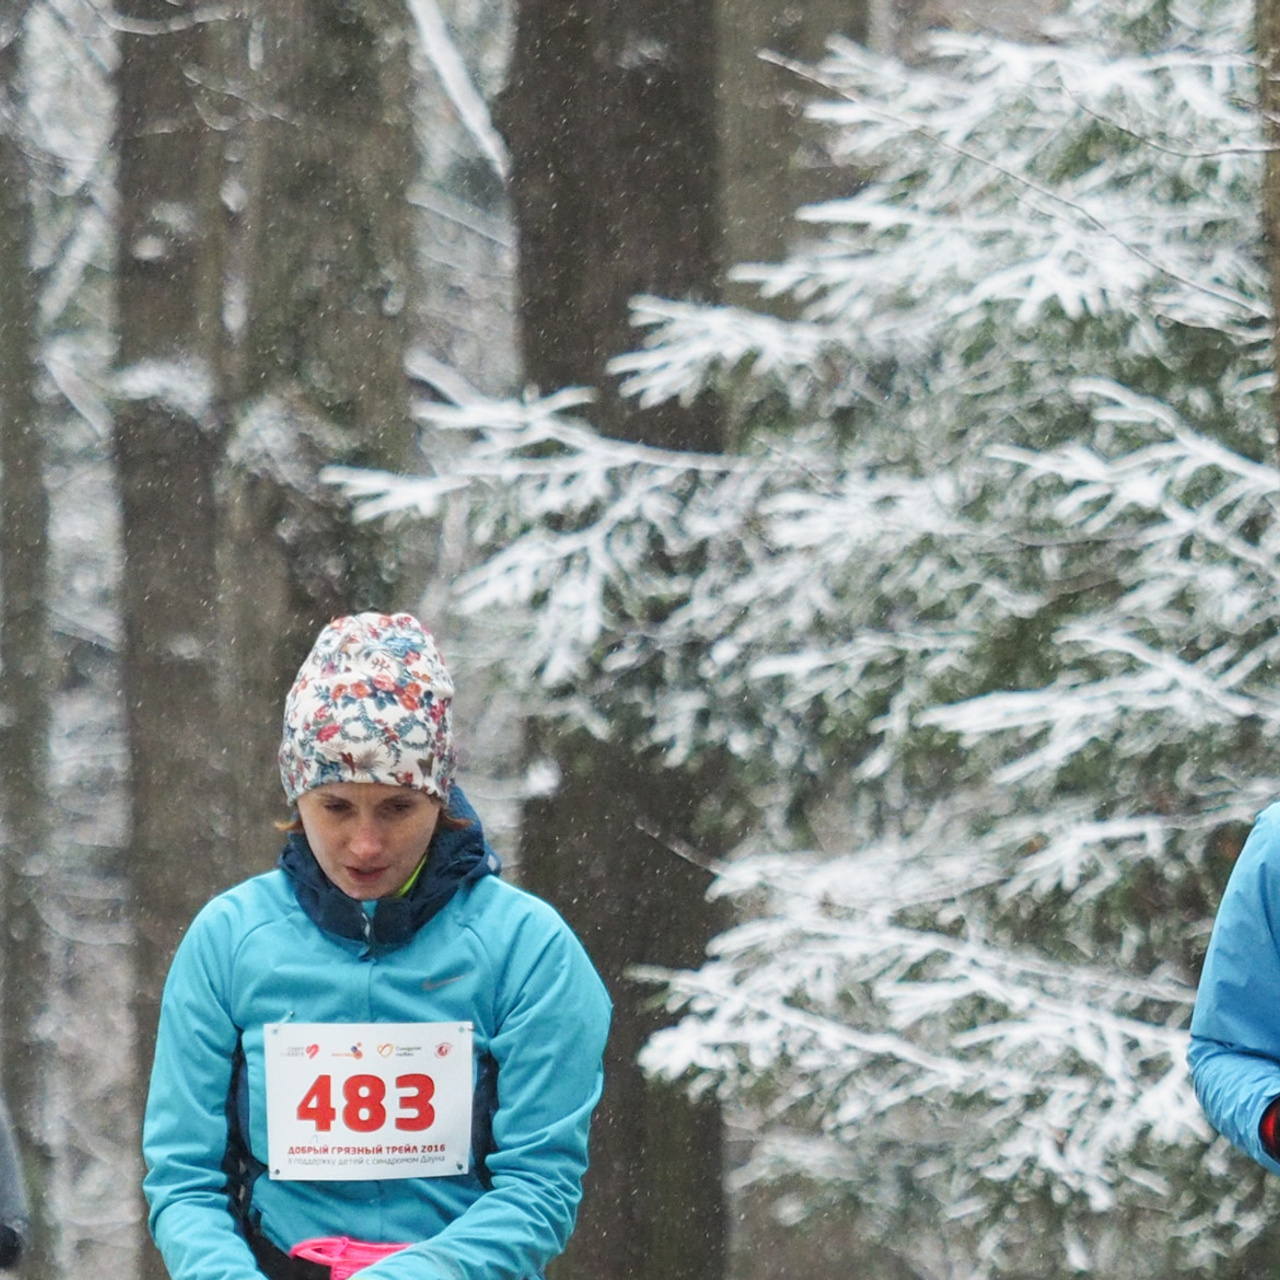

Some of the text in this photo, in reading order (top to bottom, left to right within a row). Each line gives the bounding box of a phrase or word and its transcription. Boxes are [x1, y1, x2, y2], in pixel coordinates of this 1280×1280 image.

[296, 1073, 435, 1133] 483
[288, 1144, 445, 1155] ДОБРЫЙ ГРЯЗНЫЙ ТРЕЙЛ 2016
